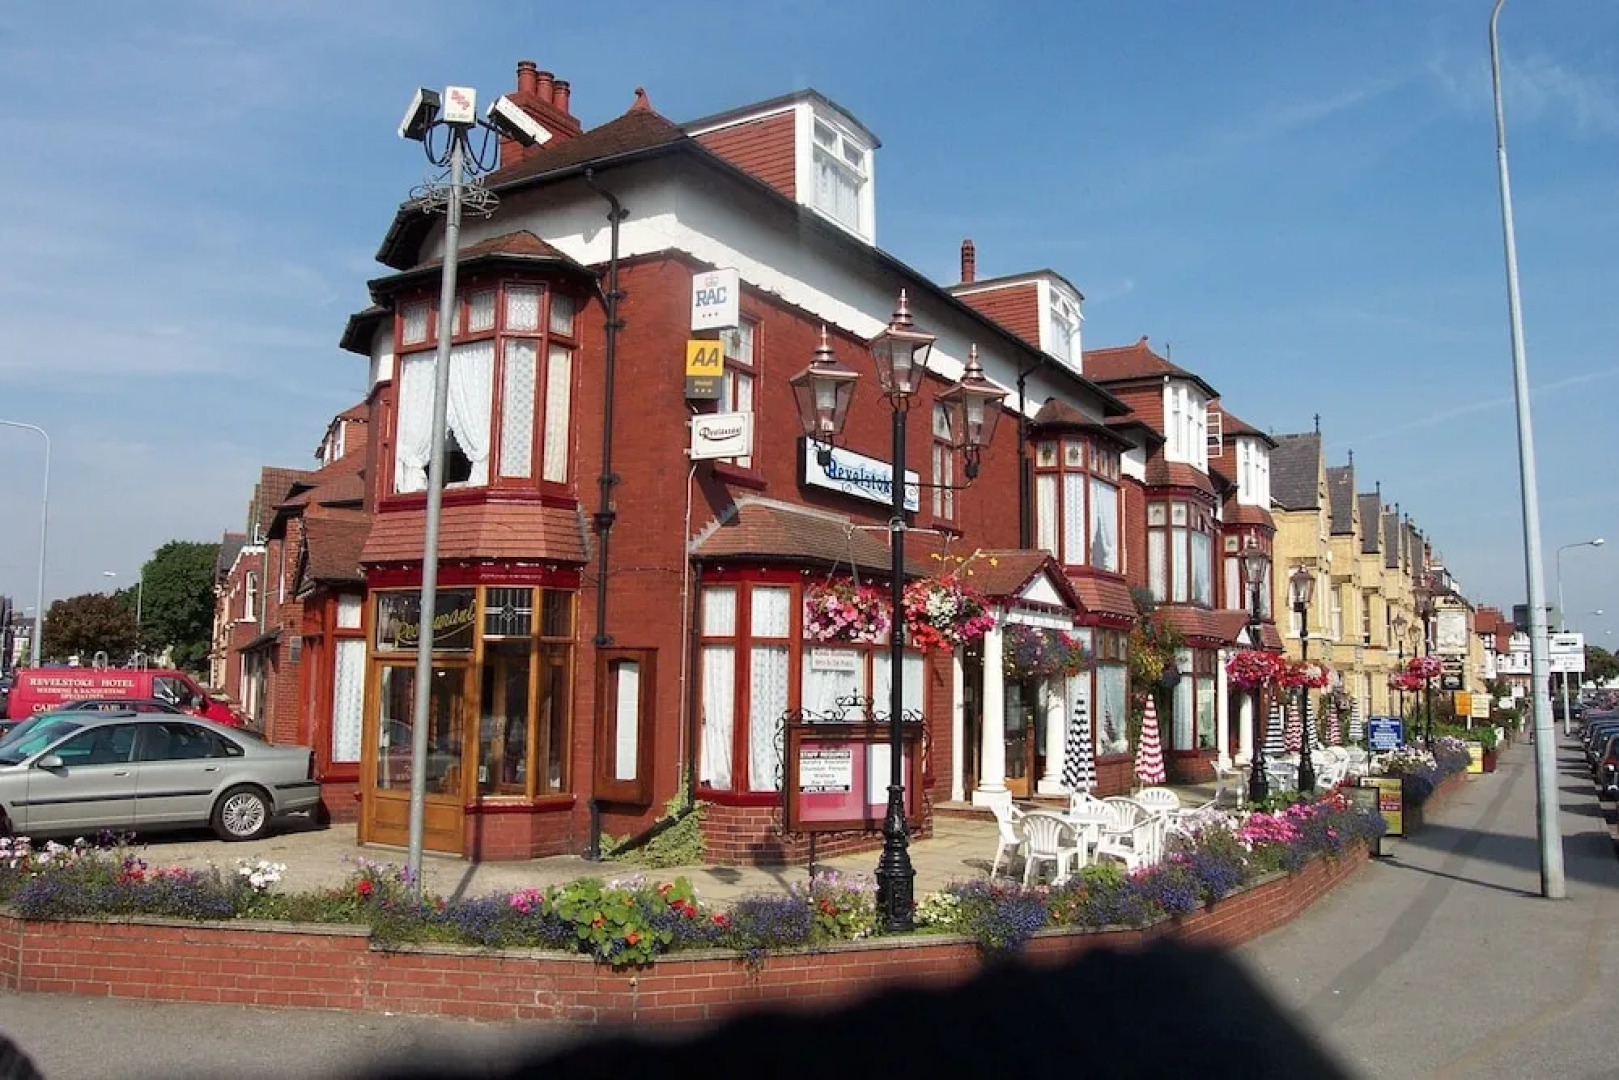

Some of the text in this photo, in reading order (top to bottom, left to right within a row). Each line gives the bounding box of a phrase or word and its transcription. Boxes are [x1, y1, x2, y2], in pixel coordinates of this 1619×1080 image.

[695, 287, 727, 307] RAC
[691, 347, 719, 367] AA
[30, 678, 135, 688] REVELSTOKE HOTEL
